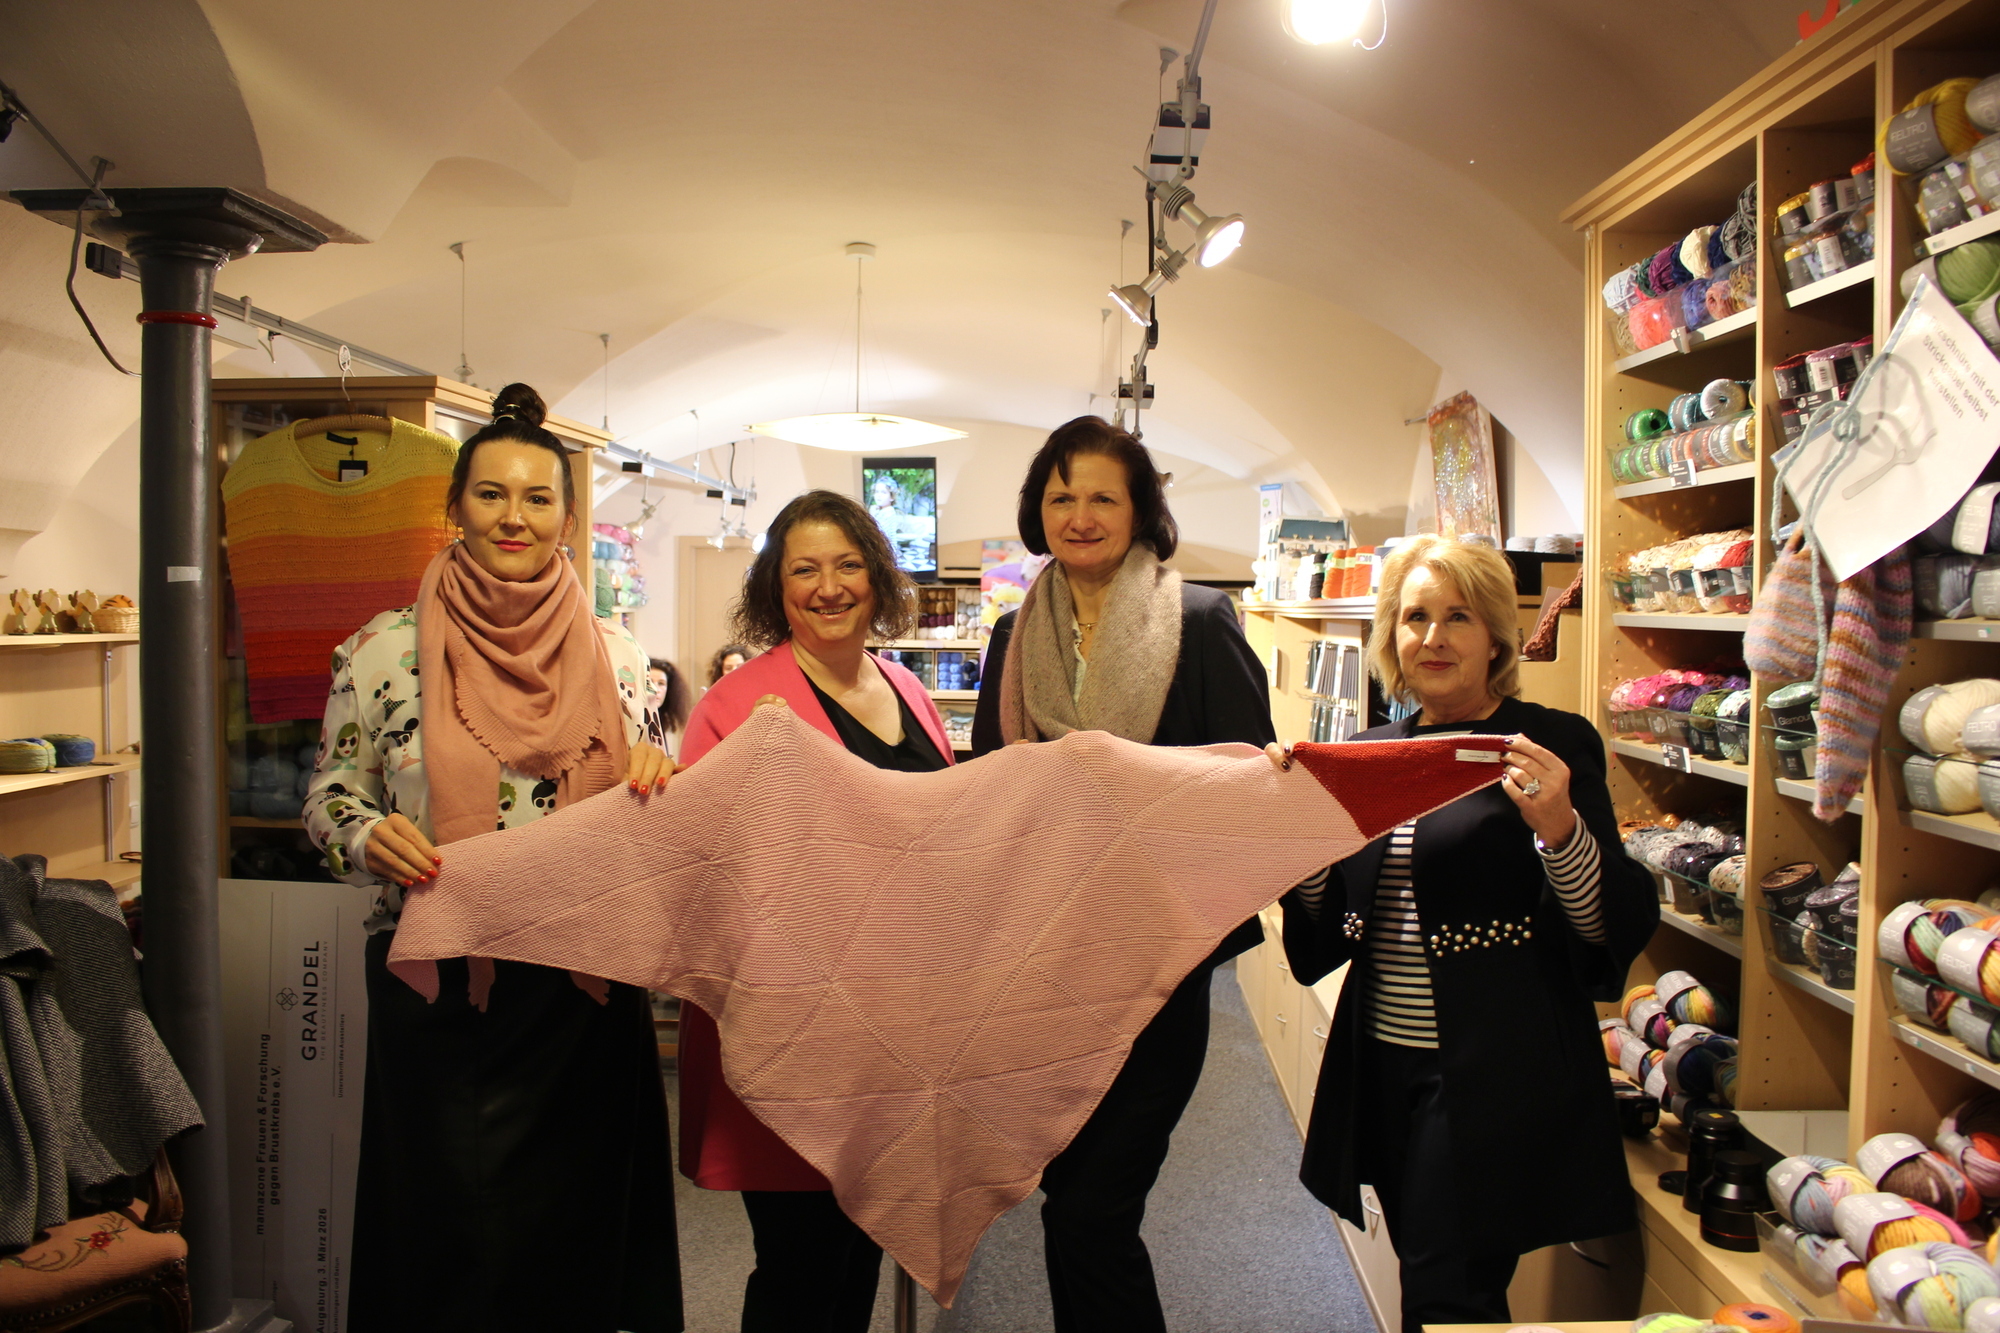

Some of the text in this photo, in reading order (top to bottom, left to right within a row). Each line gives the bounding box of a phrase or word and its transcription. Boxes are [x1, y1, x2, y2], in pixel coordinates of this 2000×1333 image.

[1890, 121, 1927, 142] FELTRO
[1927, 366, 1965, 419] herstellen
[1963, 388, 1989, 422] selbst
[1970, 371, 1986, 391] mit
[1984, 387, 2000, 407] der
[1778, 713, 1812, 726] Glamour
[1966, 720, 1998, 734] FELTRO
[1941, 953, 1973, 975] FELTRO
[301, 940, 320, 1061] GRANDEL
[320, 986, 328, 1041] BEAUTYNESS
[256, 1033, 271, 1235] mamazone Frauen & Forschung
[269, 1065, 281, 1206] gegen Brustkrebs e.V.
[1870, 1139, 1894, 1164] FELTRO
[1853, 1196, 1884, 1220] FELTRO
[316, 1208, 328, 1333] Augsburg, 3. März 2026
